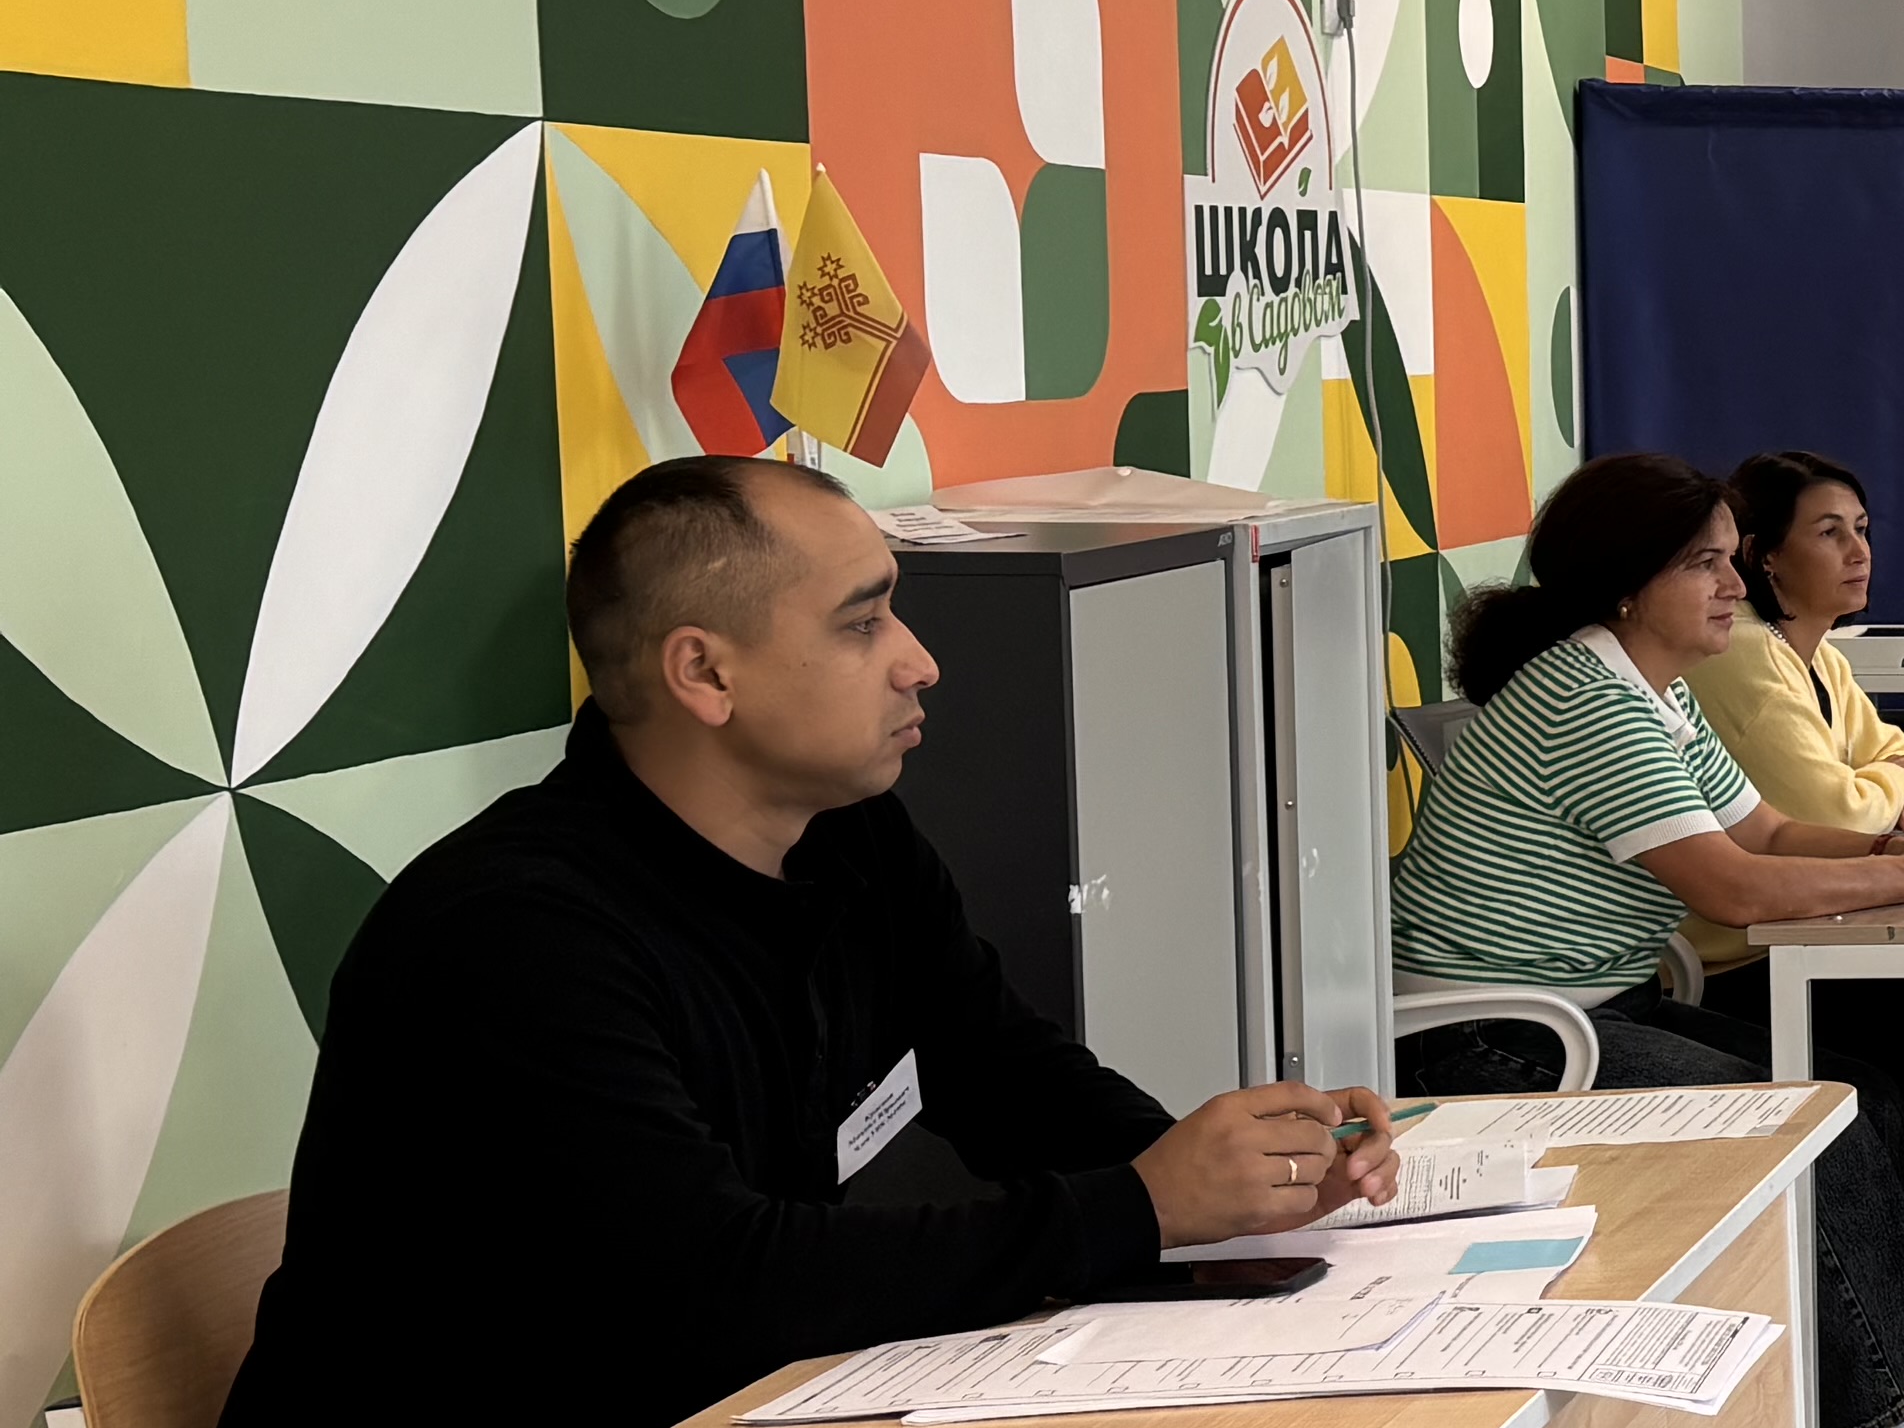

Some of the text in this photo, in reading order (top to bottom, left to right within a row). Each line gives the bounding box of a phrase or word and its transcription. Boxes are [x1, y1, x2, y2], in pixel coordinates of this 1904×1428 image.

[1194, 204, 1348, 298] ШКОЛА
[1230, 269, 1346, 376] в Садовом
